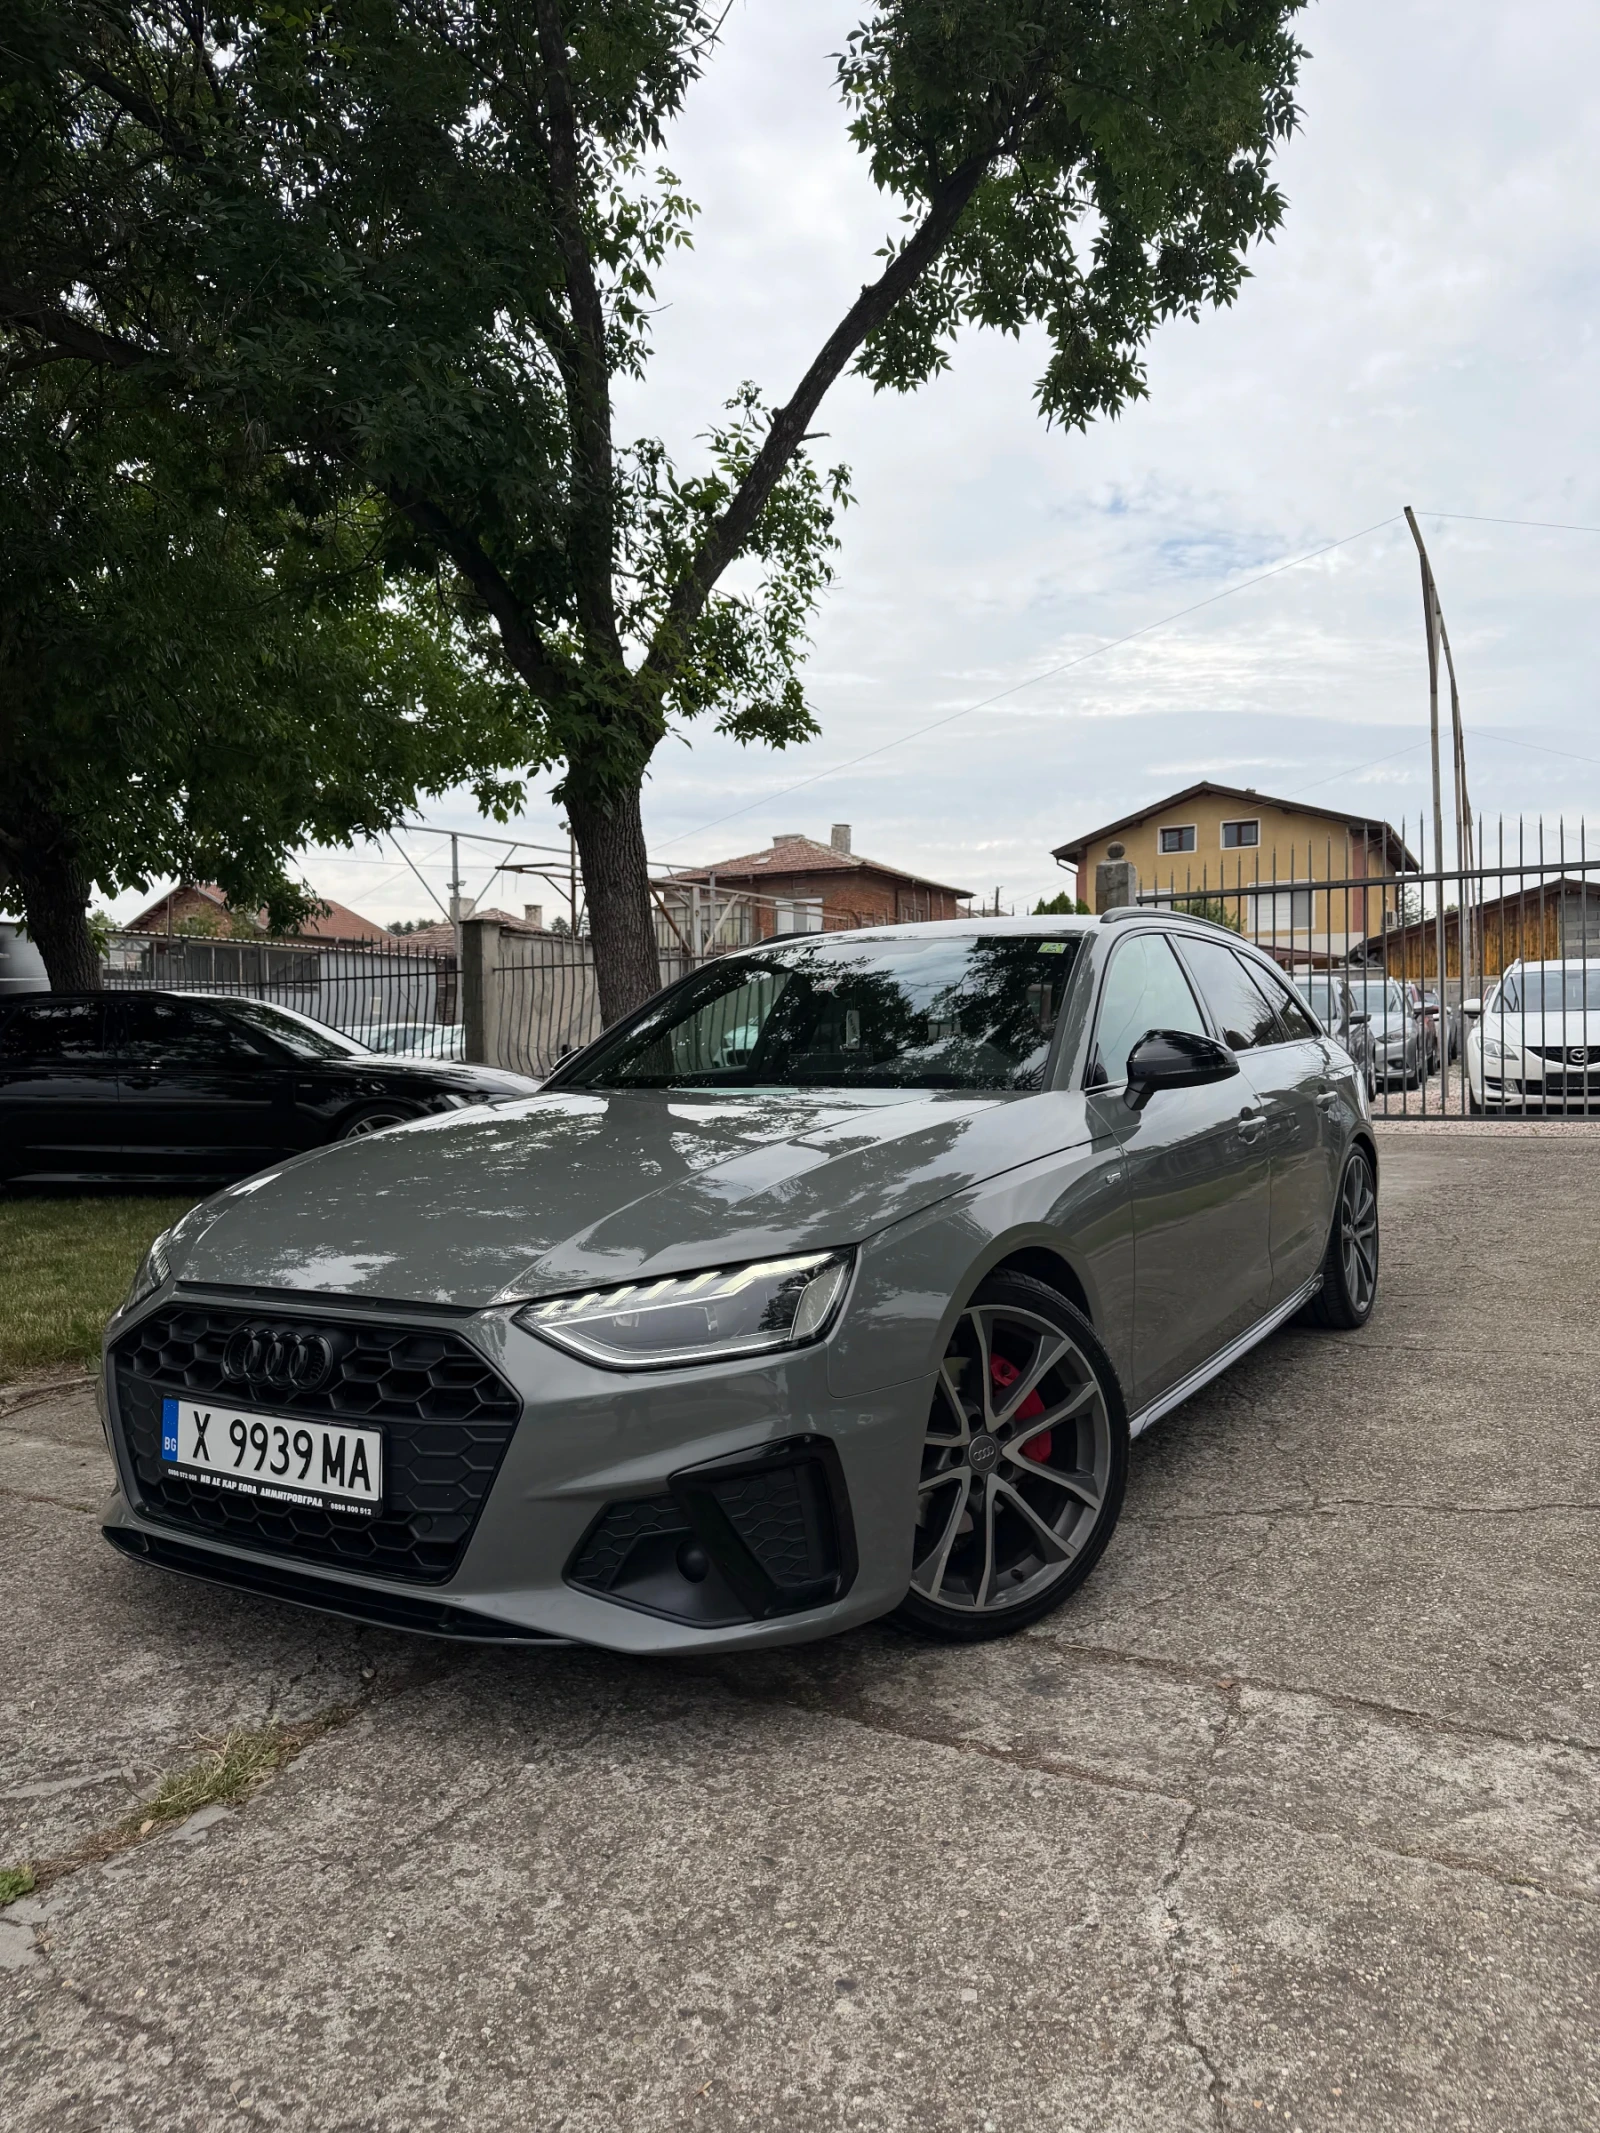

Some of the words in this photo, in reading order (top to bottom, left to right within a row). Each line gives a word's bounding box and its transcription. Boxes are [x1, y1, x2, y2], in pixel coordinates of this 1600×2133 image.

[164, 1436, 177, 1452] BG
[192, 1410, 211, 1462] X
[229, 1418, 314, 1480] 9939
[321, 1433, 372, 1492] MA
[221, 1479, 237, 1490] КАР
[260, 1487, 324, 1508] ДИМИТРОВГРАД
[346, 1504, 359, 1514] 800
[359, 1507, 372, 1516] 512
